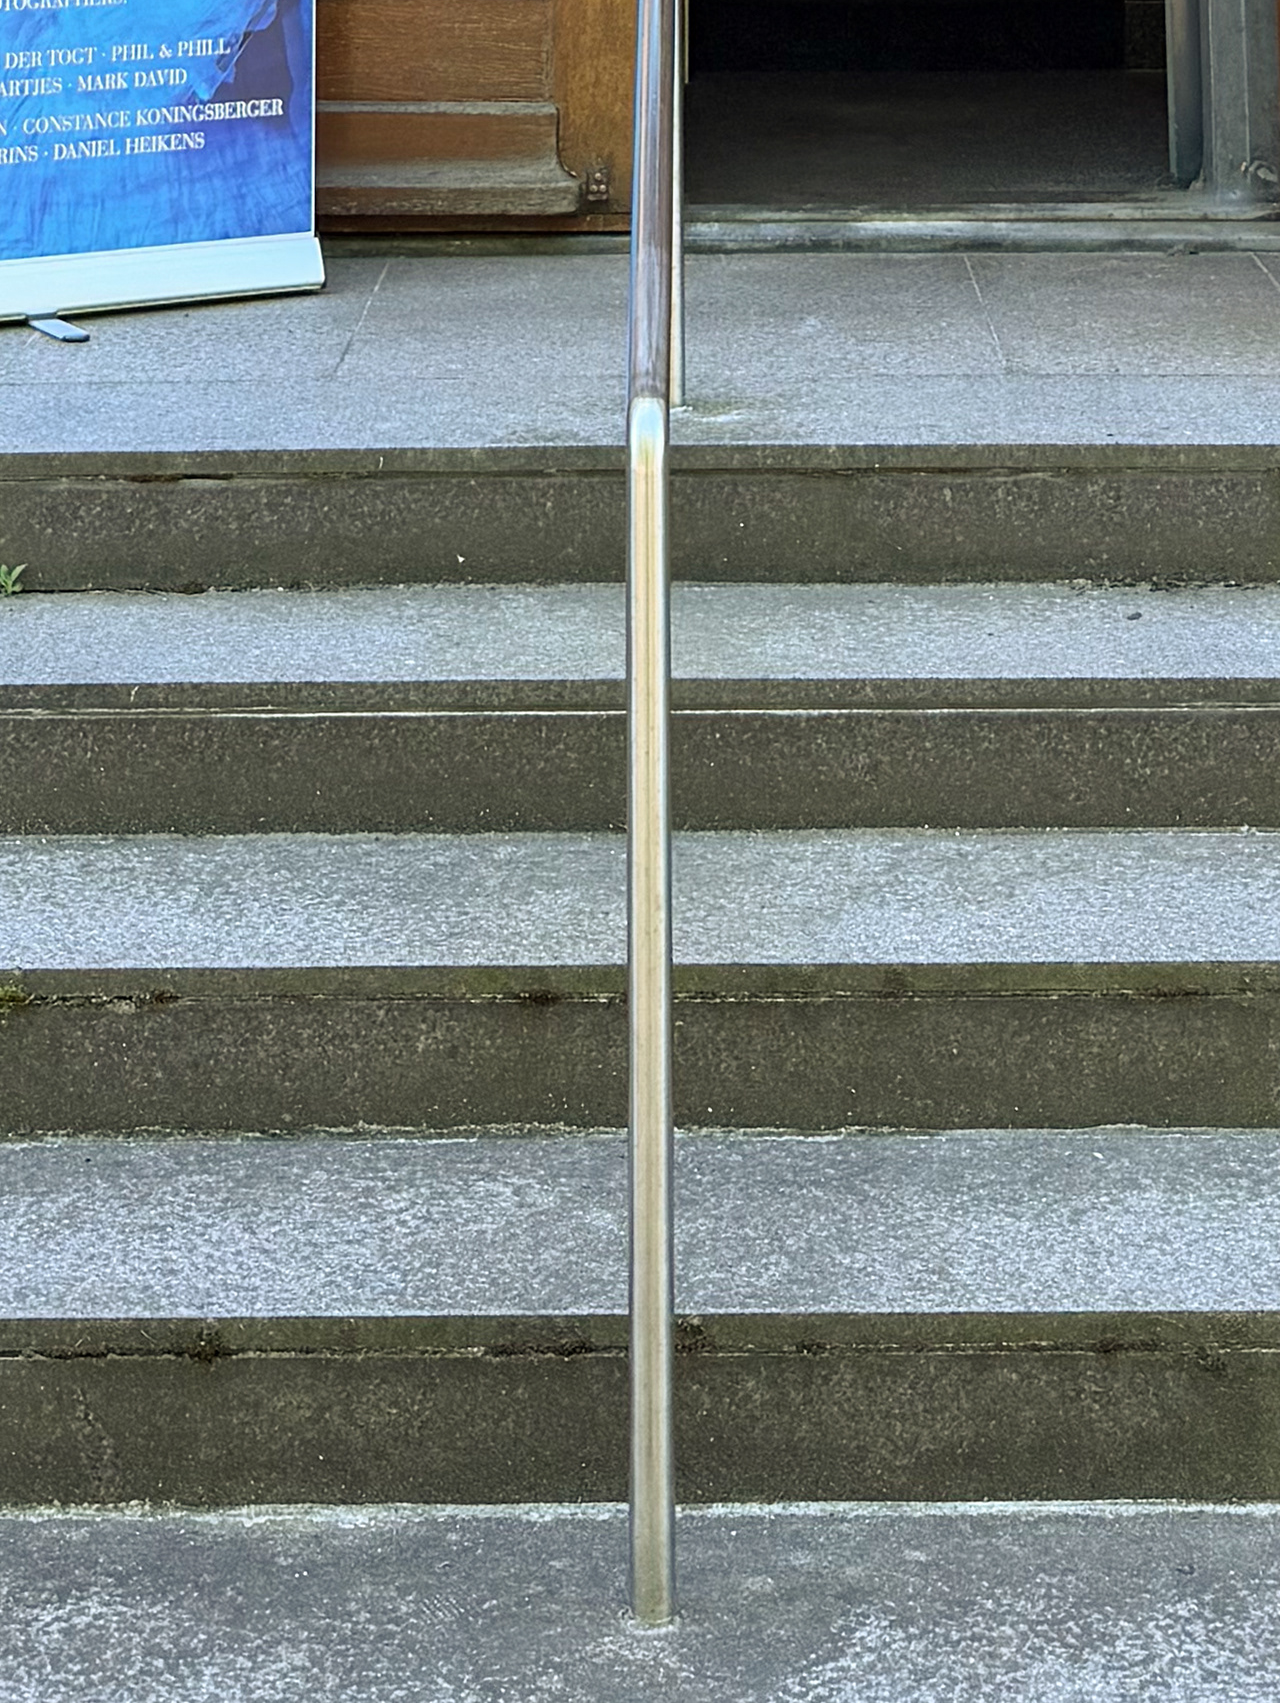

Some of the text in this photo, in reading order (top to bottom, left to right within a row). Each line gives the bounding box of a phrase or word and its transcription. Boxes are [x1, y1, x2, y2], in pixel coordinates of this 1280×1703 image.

[5, 50, 42, 70] DER
[111, 43, 154, 63] PHIL
[159, 43, 172, 59] &
[177, 37, 231, 58] PHILL
[77, 71, 129, 92] MARK
[134, 68, 187, 88] DAVID
[23, 110, 131, 135] CONSTANCE
[136, 98, 284, 127] KONINGSBERGER
[53, 139, 120, 161] DANIEL
[125, 132, 205, 156] HEIKENS
